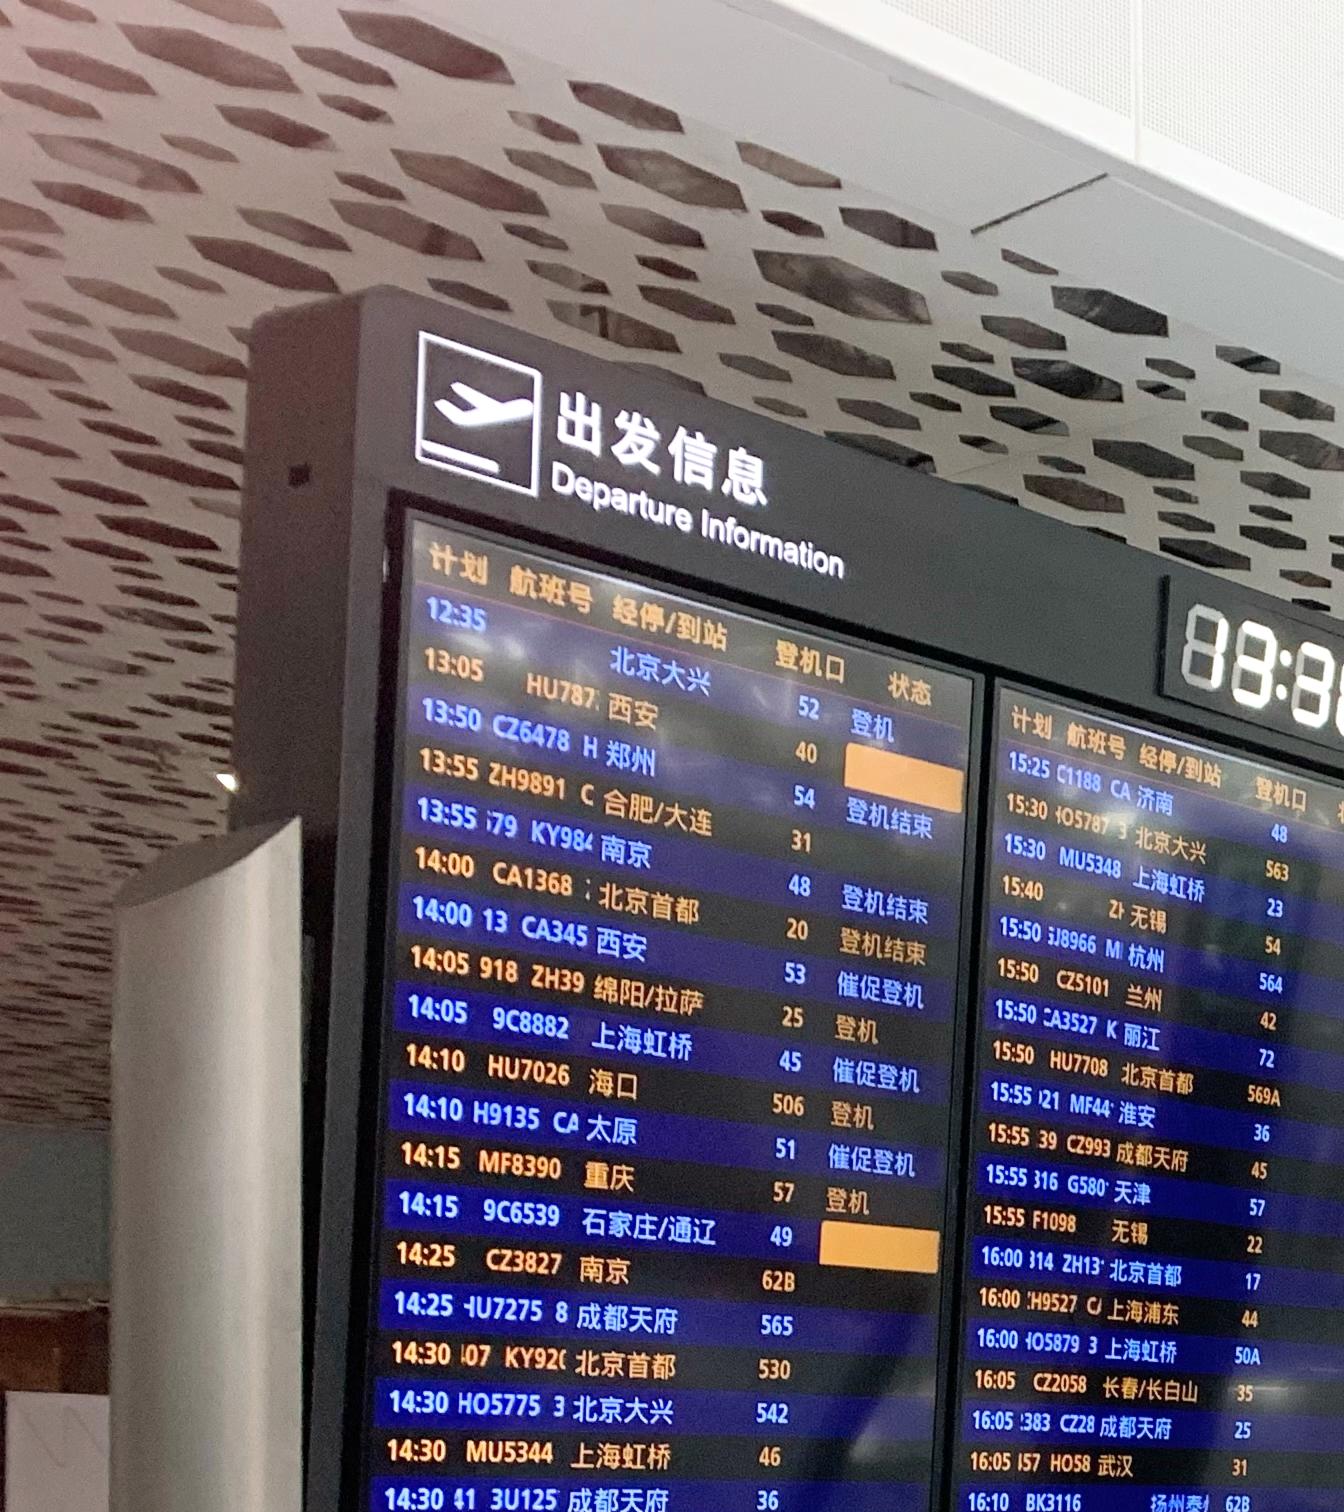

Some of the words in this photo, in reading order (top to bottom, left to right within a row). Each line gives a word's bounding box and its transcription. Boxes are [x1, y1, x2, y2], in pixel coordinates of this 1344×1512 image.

[556, 391, 768, 505] 出发信息
[551, 462, 694, 534] Departure
[700, 509, 846, 580] Information
[429, 542, 488, 586] 计划
[509, 565, 593, 614] 航班号
[611, 594, 728, 652] 经停/到站
[774, 640, 846, 687] 登机口
[887, 671, 932, 707] 状态
[426, 596, 487, 632] 12:35
[609, 645, 710, 697] 北京大兴
[798, 694, 819, 720] 52
[850, 707, 894, 742] 登机
[419, 747, 479, 780] 13:55
[488, 761, 565, 800] ZH9891
[603, 788, 712, 836] 合肥/大连
[790, 828, 811, 853] 31
[422, 697, 481, 732] 13:50
[492, 714, 570, 752] CZ6478
[605, 739, 655, 777] 郑州
[793, 784, 815, 809] 54
[845, 796, 932, 839] 登机结束
[1009, 750, 1050, 778] 15:25
[1136, 784, 1174, 816] 济南
[1270, 823, 1287, 843] 48
[1011, 706, 1052, 740] 计划
[1066, 722, 1127, 761] 航班号
[1138, 743, 1222, 788] 经停/到站
[1255, 777, 1308, 813] 登机口
[1004, 832, 1046, 860] 15:30
[1059, 845, 1121, 879] MU5348
[1132, 864, 1205, 903] 上海虹桥
[1266, 897, 1283, 917] 23
[410, 944, 470, 975] 14:05
[593, 974, 704, 1016] 绵阳/拉萨
[781, 1005, 803, 1028] 25
[834, 1013, 878, 1045] 登机
[412, 895, 472, 927] 14:00
[596, 926, 647, 962] 西安
[784, 961, 806, 984] 53
[837, 970, 924, 1009] 催促登机
[997, 957, 1039, 983] 15:50
[1056, 969, 1109, 997] CZ5101
[1124, 983, 1162, 1012] 兰州
[1259, 1010, 1277, 1030] 42
[406, 1042, 465, 1072] 14:10
[487, 1053, 570, 1086] HU7026
[588, 1067, 637, 1100] 海口
[772, 1092, 804, 1116] 506
[830, 1100, 874, 1130] 登机
[408, 993, 467, 1024] 14:05
[492, 1006, 569, 1039] 9C8882
[591, 1021, 692, 1061] 上海虹桥
[779, 1049, 801, 1072] 45
[832, 1056, 920, 1093] 催促登机
[992, 1039, 1034, 1065] 15:50
[1049, 1049, 1108, 1077] HU7708
[1120, 1061, 1194, 1095] 北京首都
[1247, 1083, 1280, 1107] 569A
[401, 1140, 460, 1169] 14:15
[478, 1149, 561, 1179] MF8390
[583, 1160, 634, 1192] 重庆
[772, 1180, 794, 1202] 57
[825, 1186, 869, 1215] 登机
[988, 1122, 1029, 1146] 15:55
[1115, 1140, 1189, 1172] 成都天府
[1250, 1160, 1268, 1179] 45
[398, 1190, 458, 1218] 14:15
[482, 1198, 560, 1227] 9C6539
[581, 1207, 716, 1245] 石家庄/通辽
[769, 1225, 792, 1247] 49
[983, 1204, 1025, 1227] 15:55
[1111, 1218, 1148, 1245] 无锡
[1246, 1234, 1262, 1254] 22
[396, 1240, 455, 1267] 14:25
[485, 1248, 562, 1274] CZ3827
[579, 1254, 631, 1284] 南京
[761, 1269, 795, 1292] 62B
[389, 1389, 449, 1414] 14:30
[572, 1394, 673, 1424] 北京大兴
[756, 1402, 788, 1424] 542
[974, 1368, 1016, 1390] 16:05
[1032, 1372, 1087, 1393] CZ2058
[1101, 1375, 1198, 1403] 长春/长白山
[1236, 1386, 1253, 1402] 35
[386, 1437, 446, 1462] 14:30
[465, 1439, 553, 1464] MU5344
[569, 1441, 671, 1470] 上海虹桥
[758, 1445, 781, 1466] 46
[967, 1492, 1009, 1512] 16:10
[1025, 1492, 1081, 1512] BK3116
[1225, 1495, 1250, 1512] 62B
